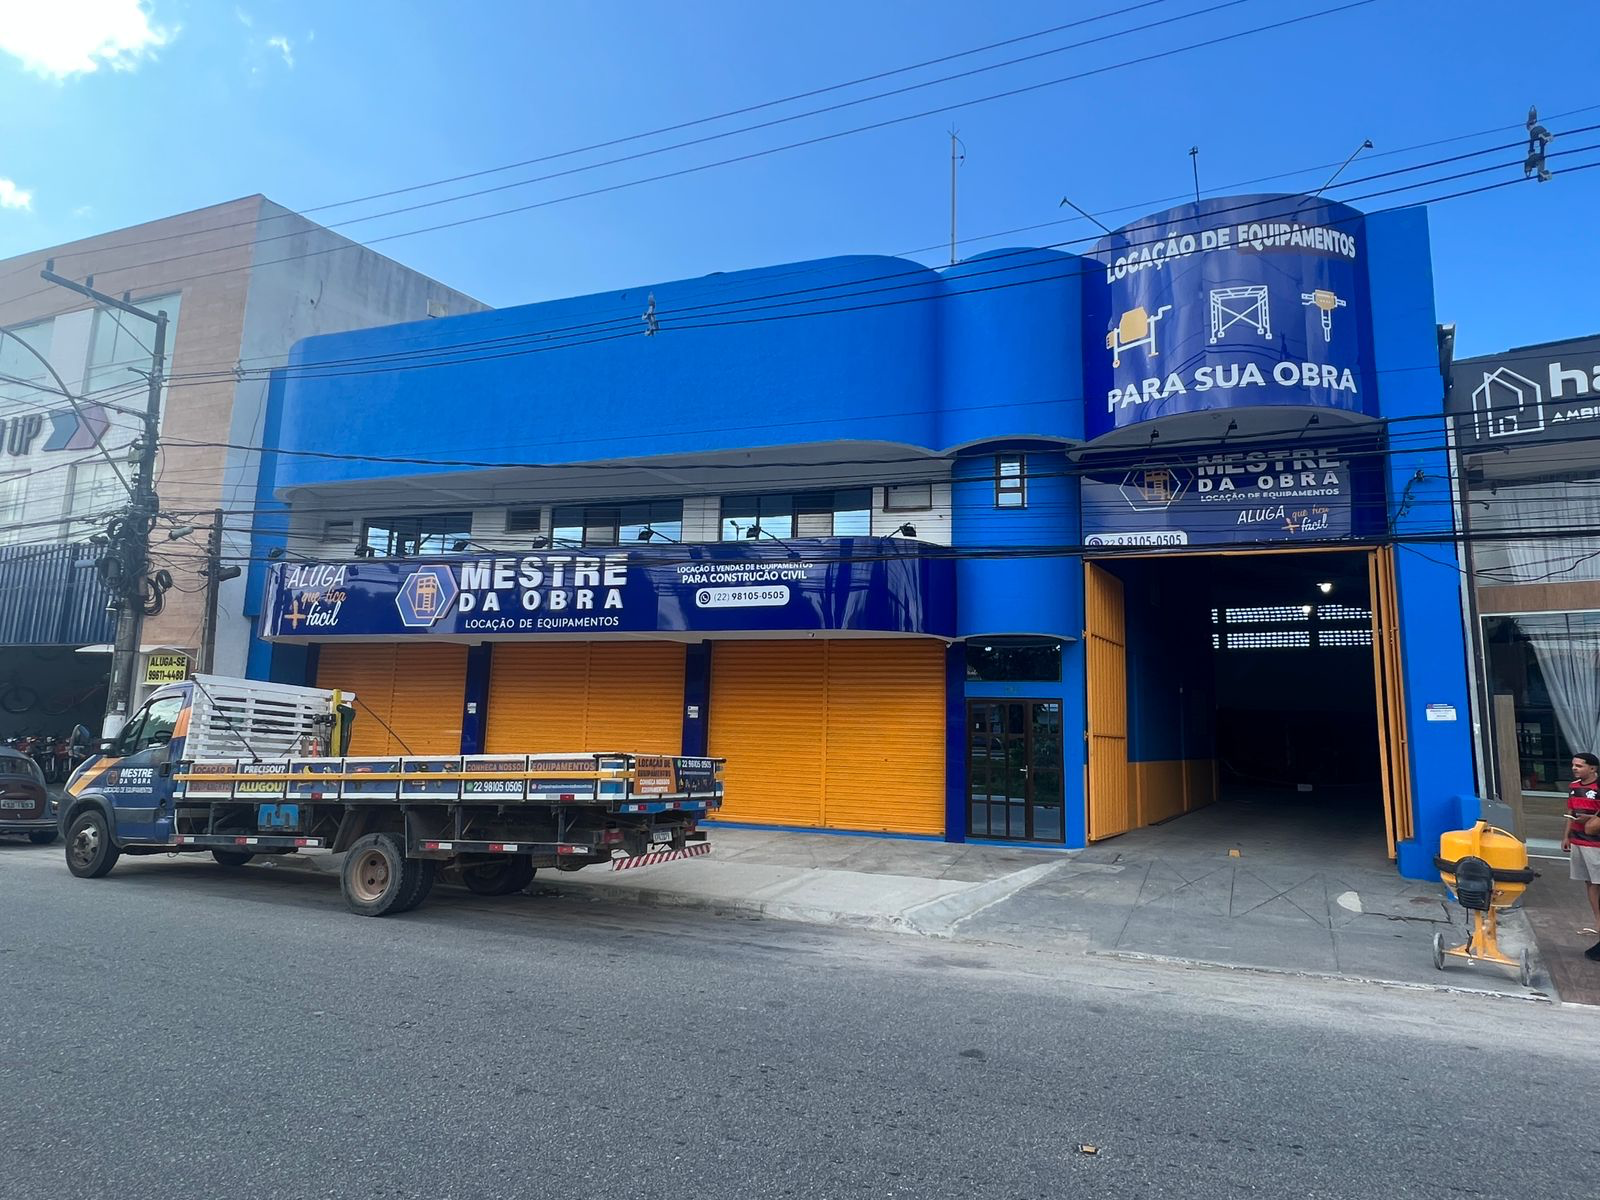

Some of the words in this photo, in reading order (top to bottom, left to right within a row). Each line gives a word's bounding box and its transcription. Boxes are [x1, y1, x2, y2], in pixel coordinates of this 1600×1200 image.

[1106, 232, 1196, 284] LOCAÇÃO
[1201, 227, 1230, 250] DE
[1238, 223, 1356, 259] EQUIPAMENTOS
[1107, 373, 1187, 413] PARA
[1194, 363, 1265, 391] SUA
[1272, 361, 1358, 393] OBRA
[0, 413, 42, 457] UP
[1197, 448, 1340, 476] MESTRE
[1198, 477, 1236, 493] DA
[1257, 471, 1340, 490] OBRA
[1200, 492, 1246, 502] LOCAÇÃO
[1263, 488, 1340, 500] EQUIPAMENTOS
[1236, 505, 1285, 525] ALUGA
[1301, 513, 1329, 533] fácil
[460, 553, 629, 590] MESTRE
[677, 565, 710, 574] LOCAÇÃO
[716, 564, 744, 572] VENDAS
[756, 561, 813, 570] EQUIPAMENTOS
[287, 565, 347, 589] ALUGA
[682, 574, 708, 584] PARA
[780, 570, 807, 580] CIVIL
[301, 591, 321, 606] que
[458, 592, 501, 612] DA
[522, 588, 624, 611] OBRA
[713, 592, 730, 602] (22)
[731, 591, 785, 601] 98105-0505
[305, 601, 342, 627] fácil
[465, 617, 515, 631] LOCAÇÃO
[519, 618, 533, 628] DE
[537, 616, 619, 629] EQUIPAMENTOS
[150, 656, 186, 667] ALUGA-SE
[120, 768, 154, 778] MESTRE
[244, 765, 285, 773] PRECISOU?
[531, 761, 596, 771] EQUIPAMENTOS
[473, 781, 482, 792] 22
[483, 781, 504, 792] 98105
[505, 781, 523, 792] 0505
